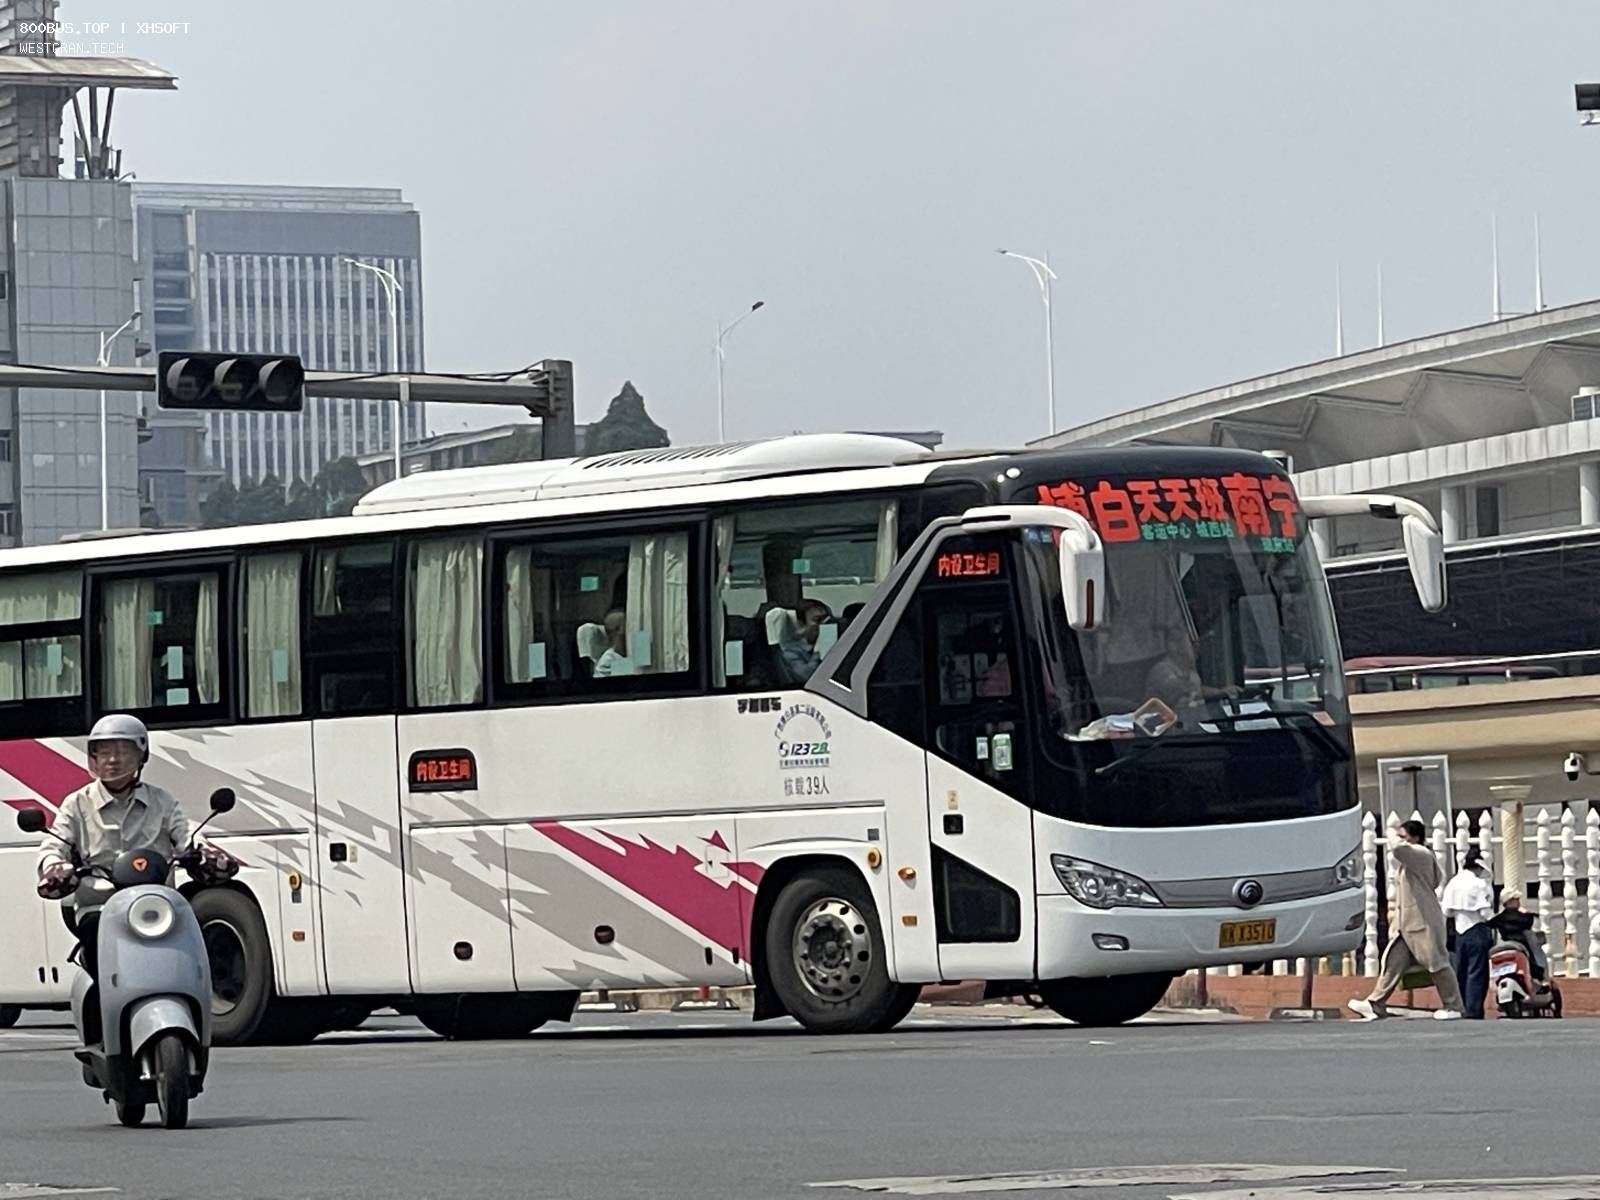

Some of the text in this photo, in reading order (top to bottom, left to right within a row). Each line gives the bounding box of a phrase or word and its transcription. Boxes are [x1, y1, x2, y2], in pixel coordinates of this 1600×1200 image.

[939, 553, 999, 576] 内设卫生间
[417, 760, 470, 781] 内设卫生间
